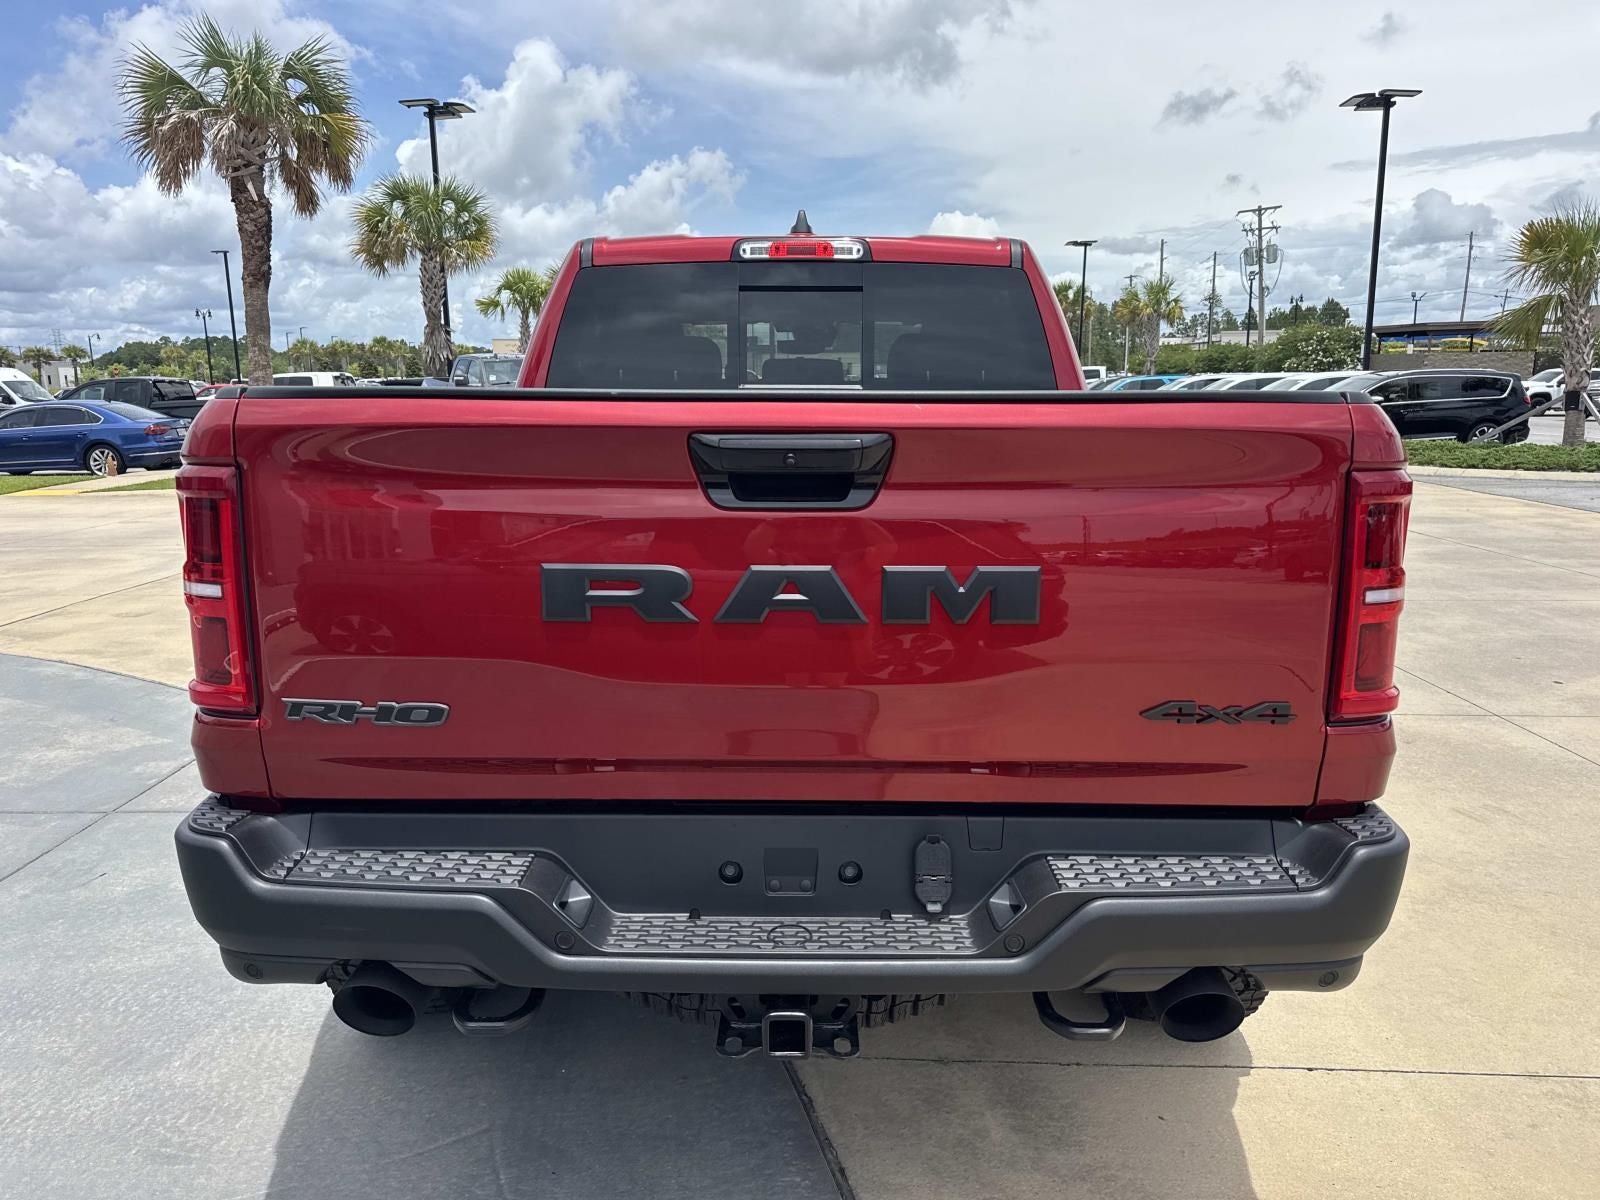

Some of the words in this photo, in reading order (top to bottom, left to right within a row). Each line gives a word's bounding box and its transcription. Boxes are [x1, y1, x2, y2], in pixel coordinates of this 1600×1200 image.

[541, 562, 1042, 625] RAM
[281, 697, 449, 727] RHO
[1139, 700, 1297, 725] 4x4
